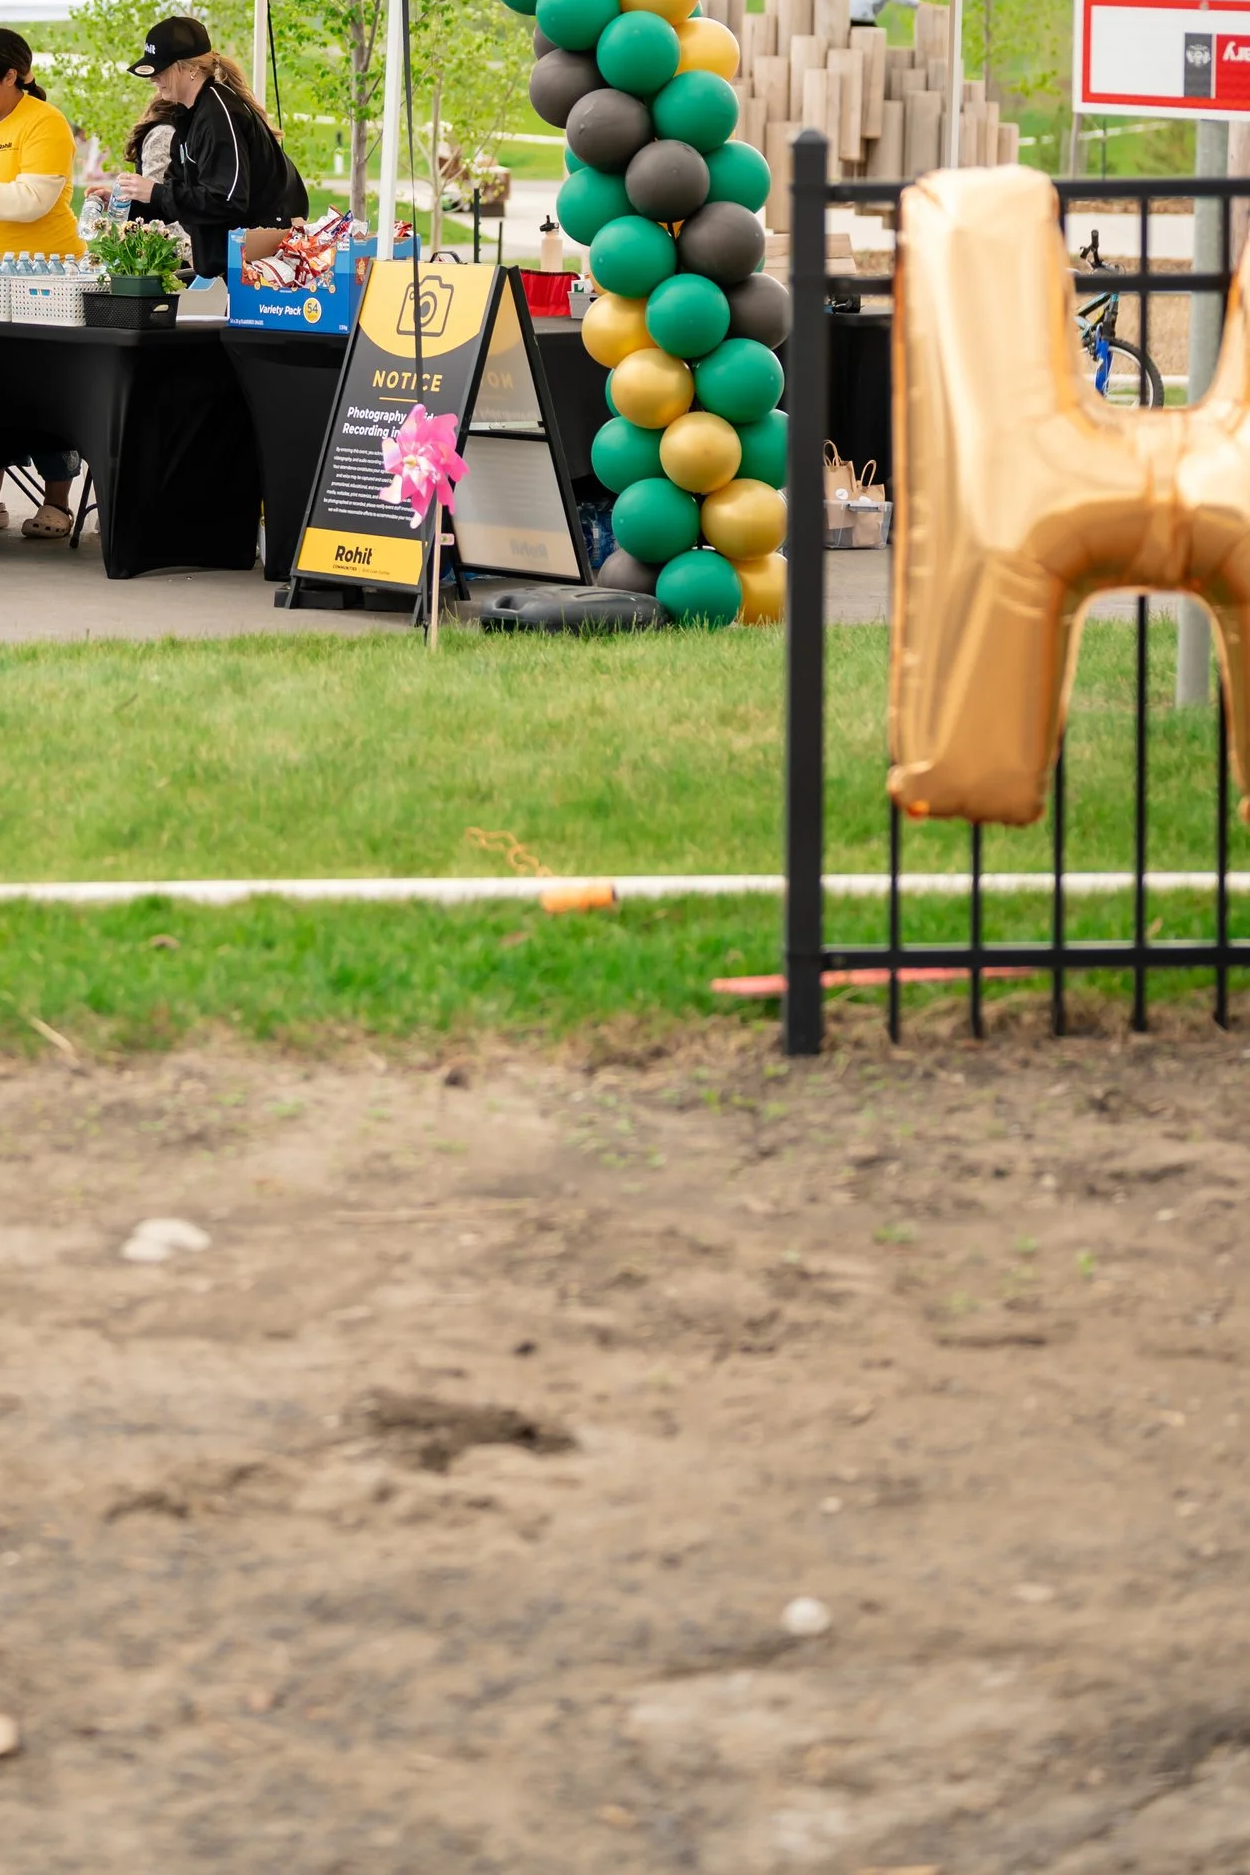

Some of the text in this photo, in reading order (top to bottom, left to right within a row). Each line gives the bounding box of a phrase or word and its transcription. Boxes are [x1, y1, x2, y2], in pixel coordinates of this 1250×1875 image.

[259, 304, 302, 316] Variety Pack
[307, 303, 318, 314] 54
[372, 369, 443, 393] NOTICE
[347, 406, 407, 424] Photography
[342, 423, 390, 439] Recording
[335, 544, 373, 566] Rohit
